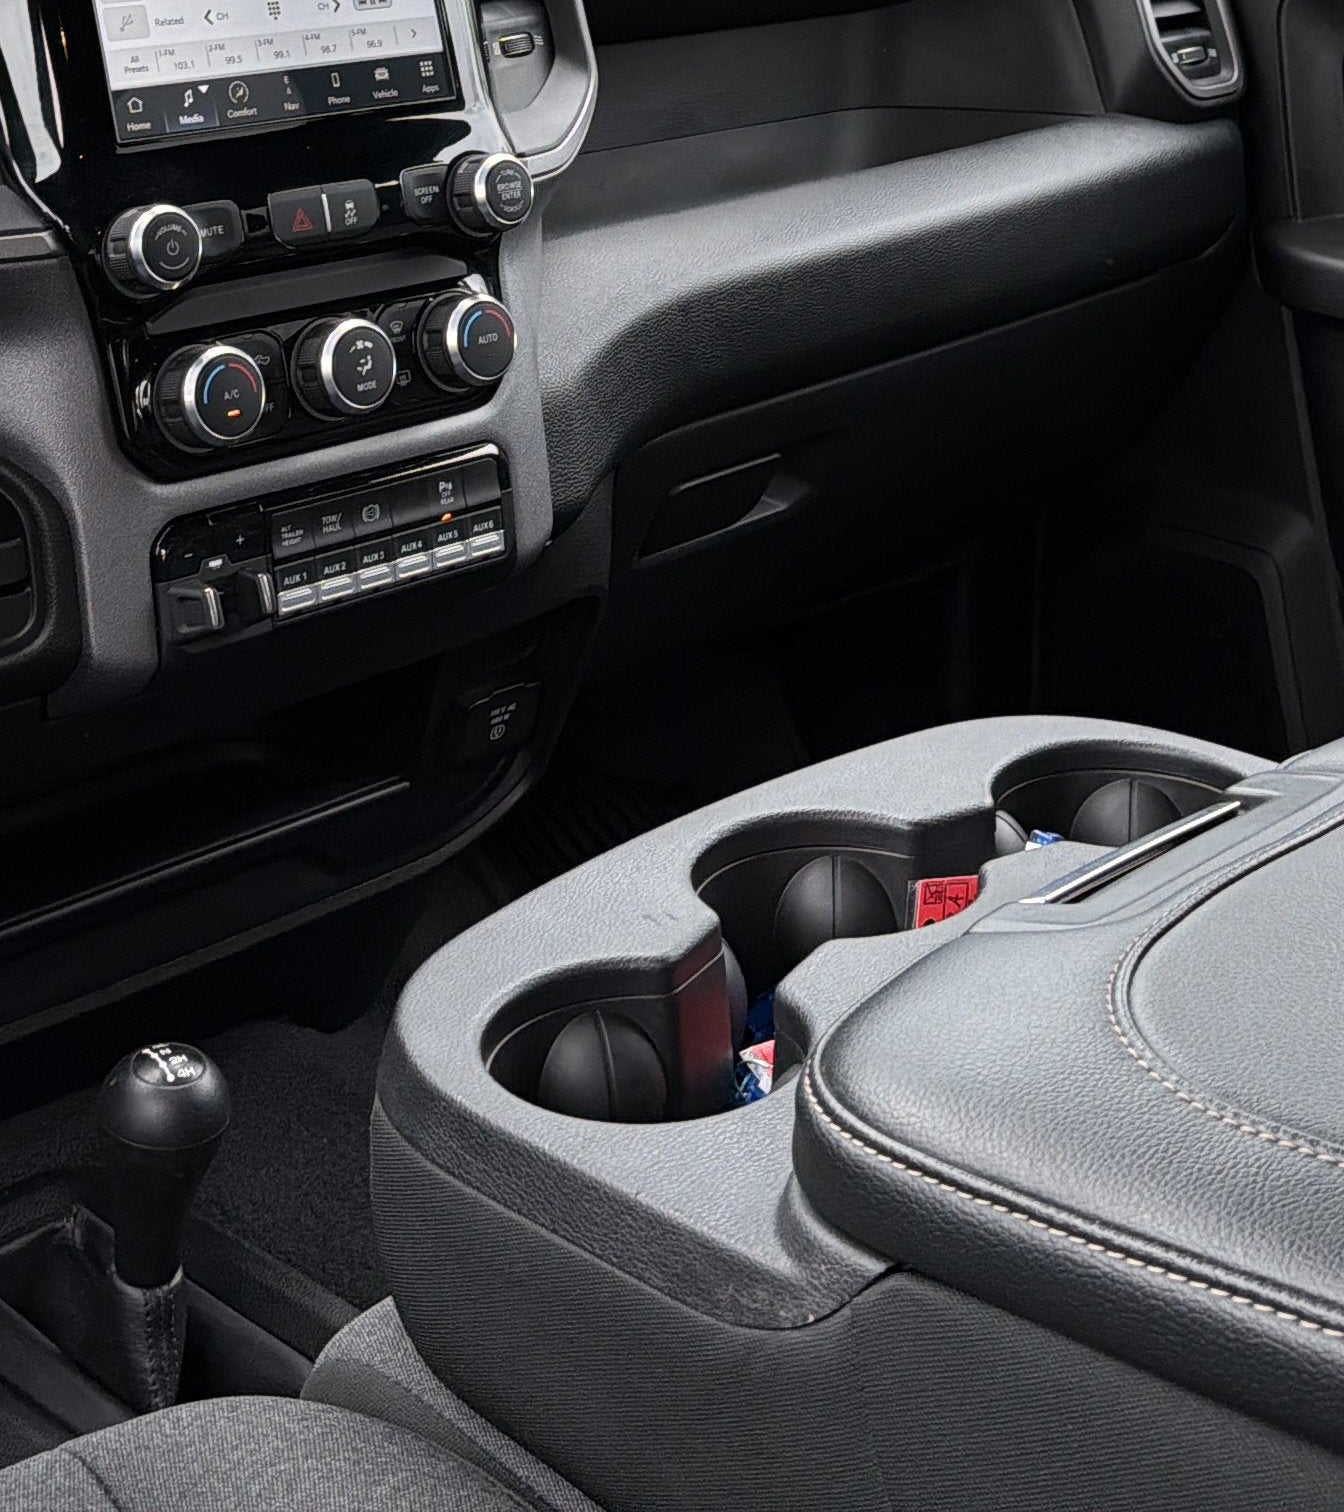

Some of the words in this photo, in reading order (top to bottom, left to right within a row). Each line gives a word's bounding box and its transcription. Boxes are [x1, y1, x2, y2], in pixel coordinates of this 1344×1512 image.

[154, 17, 184, 27] Related
[124, 64, 149, 74] Presets
[372, 88, 399, 99] Vehicle
[422, 84, 440, 94] Apps
[328, 95, 351, 106] Phone
[284, 102, 300, 111] Nav
[227, 107, 258, 119] Comfort
[179, 113, 204, 125] Media
[127, 121, 152, 132] Home
[497, 180, 522, 191] BROWSE
[420, 195, 432, 204] OFF
[501, 191, 521, 200] ENTER
[345, 217, 357, 226] OFF
[478, 332, 498, 345] AUTO
[357, 381, 377, 392] MODE
[224, 389, 240, 400] A/C
[323, 523, 342, 534] HAUL
[473, 522, 488, 532] AUX
[281, 529, 304, 539] TRAILER
[438, 533, 453, 542] AUX
[401, 543, 417, 553] AUX
[362, 553, 378, 564] AUX
[323, 563, 341, 575] AUX
[283, 574, 301, 586] AUX
[169, 1054, 188, 1065] 2H
[177, 1067, 196, 1078] 4H
